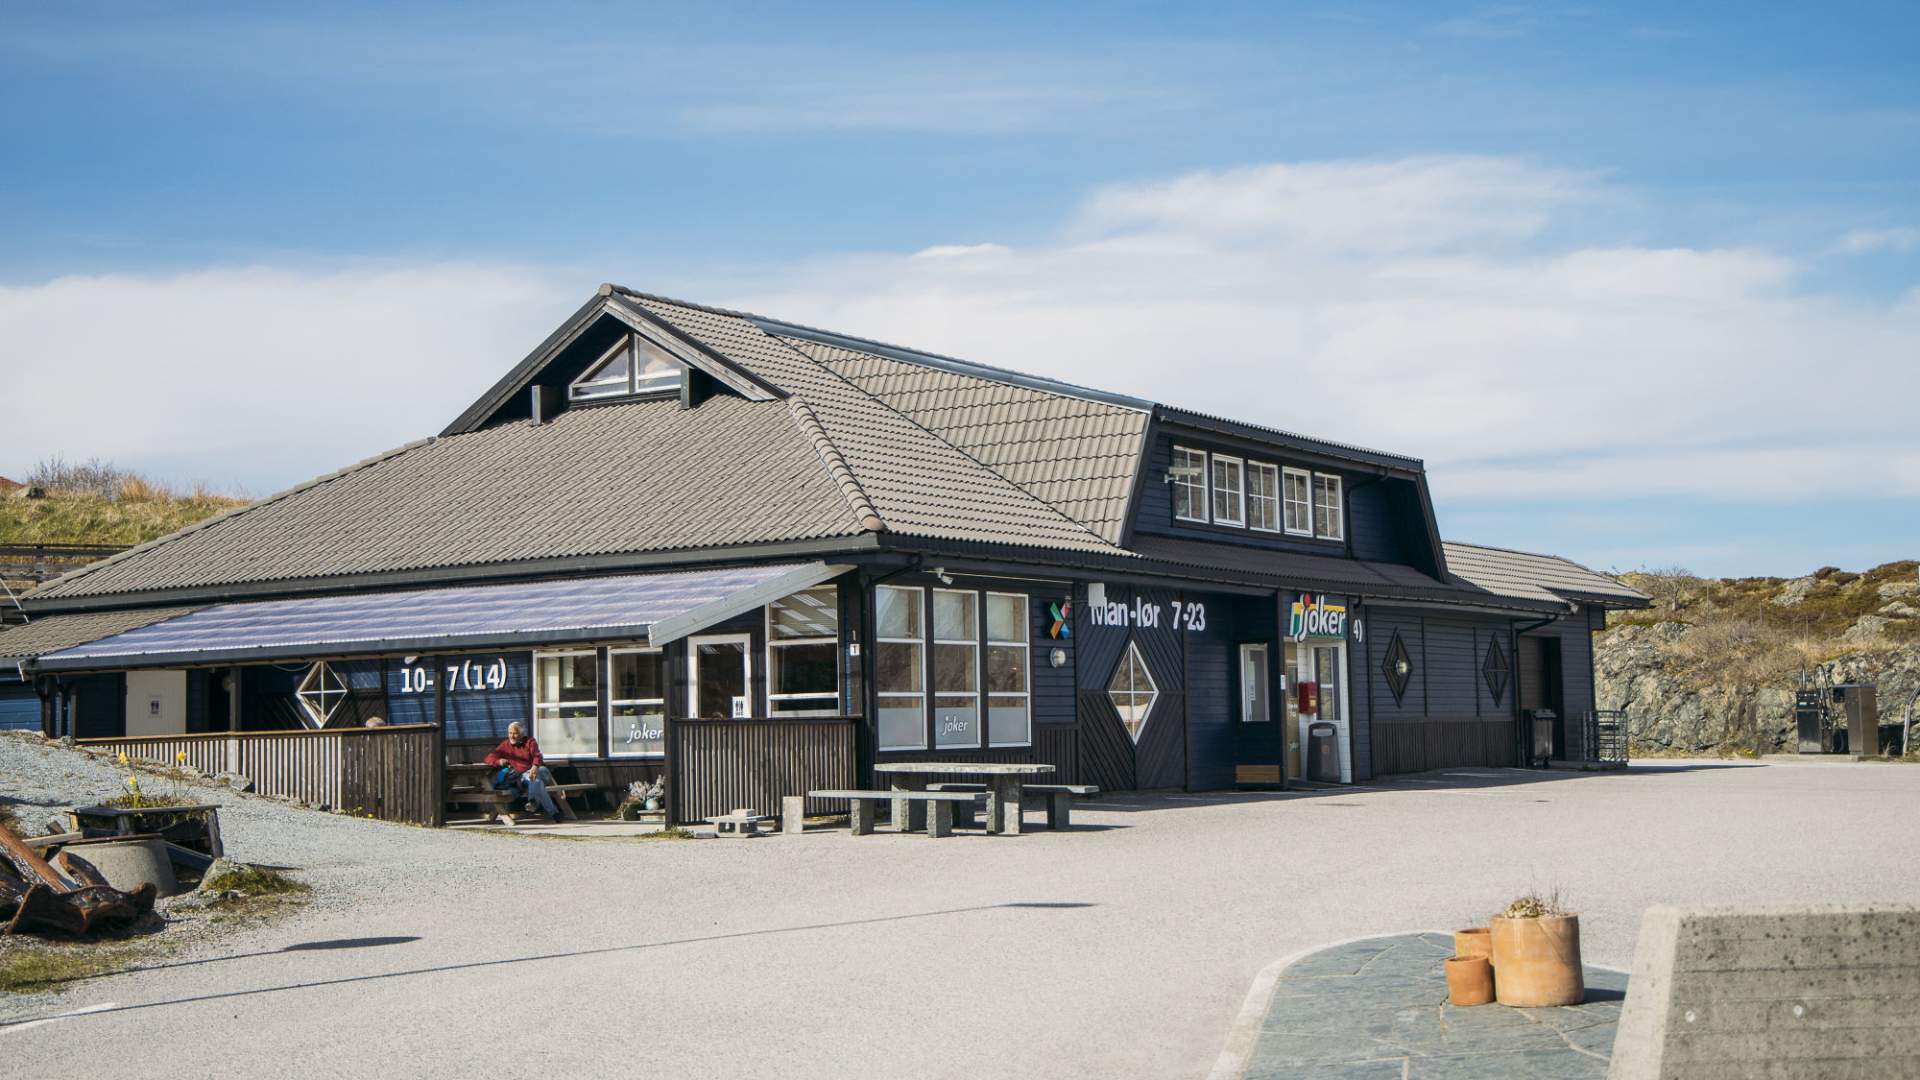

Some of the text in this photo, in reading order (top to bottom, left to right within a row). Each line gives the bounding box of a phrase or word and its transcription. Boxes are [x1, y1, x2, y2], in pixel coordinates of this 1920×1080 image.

[1171, 601, 1206, 631] 7-23
[1299, 593, 1346, 642] joker
[626, 722, 664, 744] joker
[942, 715, 968, 736] joker
